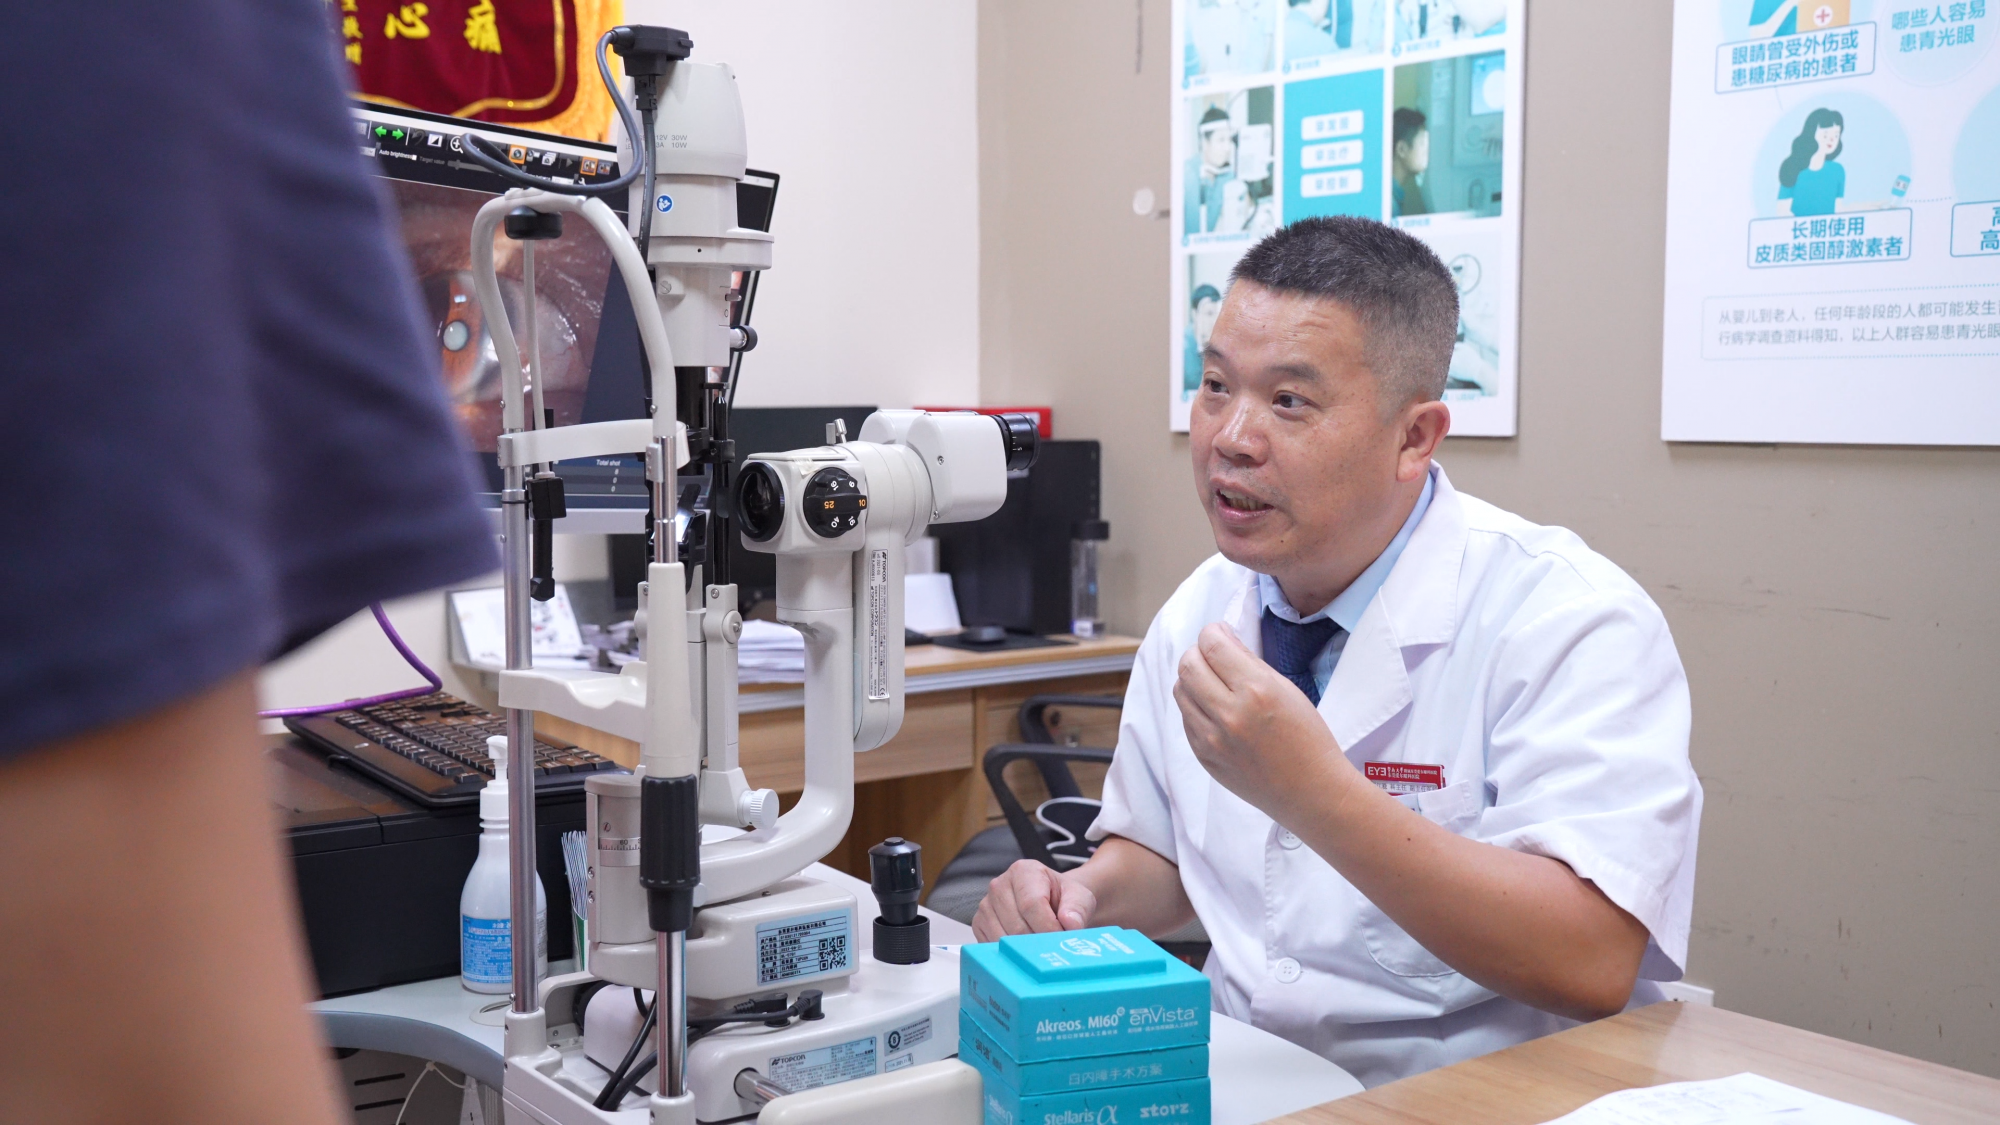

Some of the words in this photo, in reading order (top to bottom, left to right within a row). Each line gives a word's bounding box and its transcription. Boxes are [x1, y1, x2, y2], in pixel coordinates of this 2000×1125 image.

[1892, 0, 1985, 30] 哪些人容易
[1732, 29, 1859, 66] 眼睛曾受外伤或
[1899, 24, 1975, 53] 患青光眼
[1731, 52, 1857, 87] 患糖尿病的患者
[1791, 216, 1864, 240] 长期使用
[1755, 236, 1903, 264] 皮质类固醇激素者
[1719, 299, 2000, 324] 从婴儿到老人，任何年龄段的人都可能发生
[859, 499, 866, 507] 10
[1036, 1018, 1081, 1034] Akreos
[1088, 1013, 1119, 1029] MI60
[1129, 1005, 1195, 1026] enVista
[780, 1054, 806, 1064] TOPCON
[1068, 1063, 1163, 1086] 白内障手术方案
[1044, 1108, 1094, 1125] Stellaris
[1140, 1103, 1189, 1118] storz
